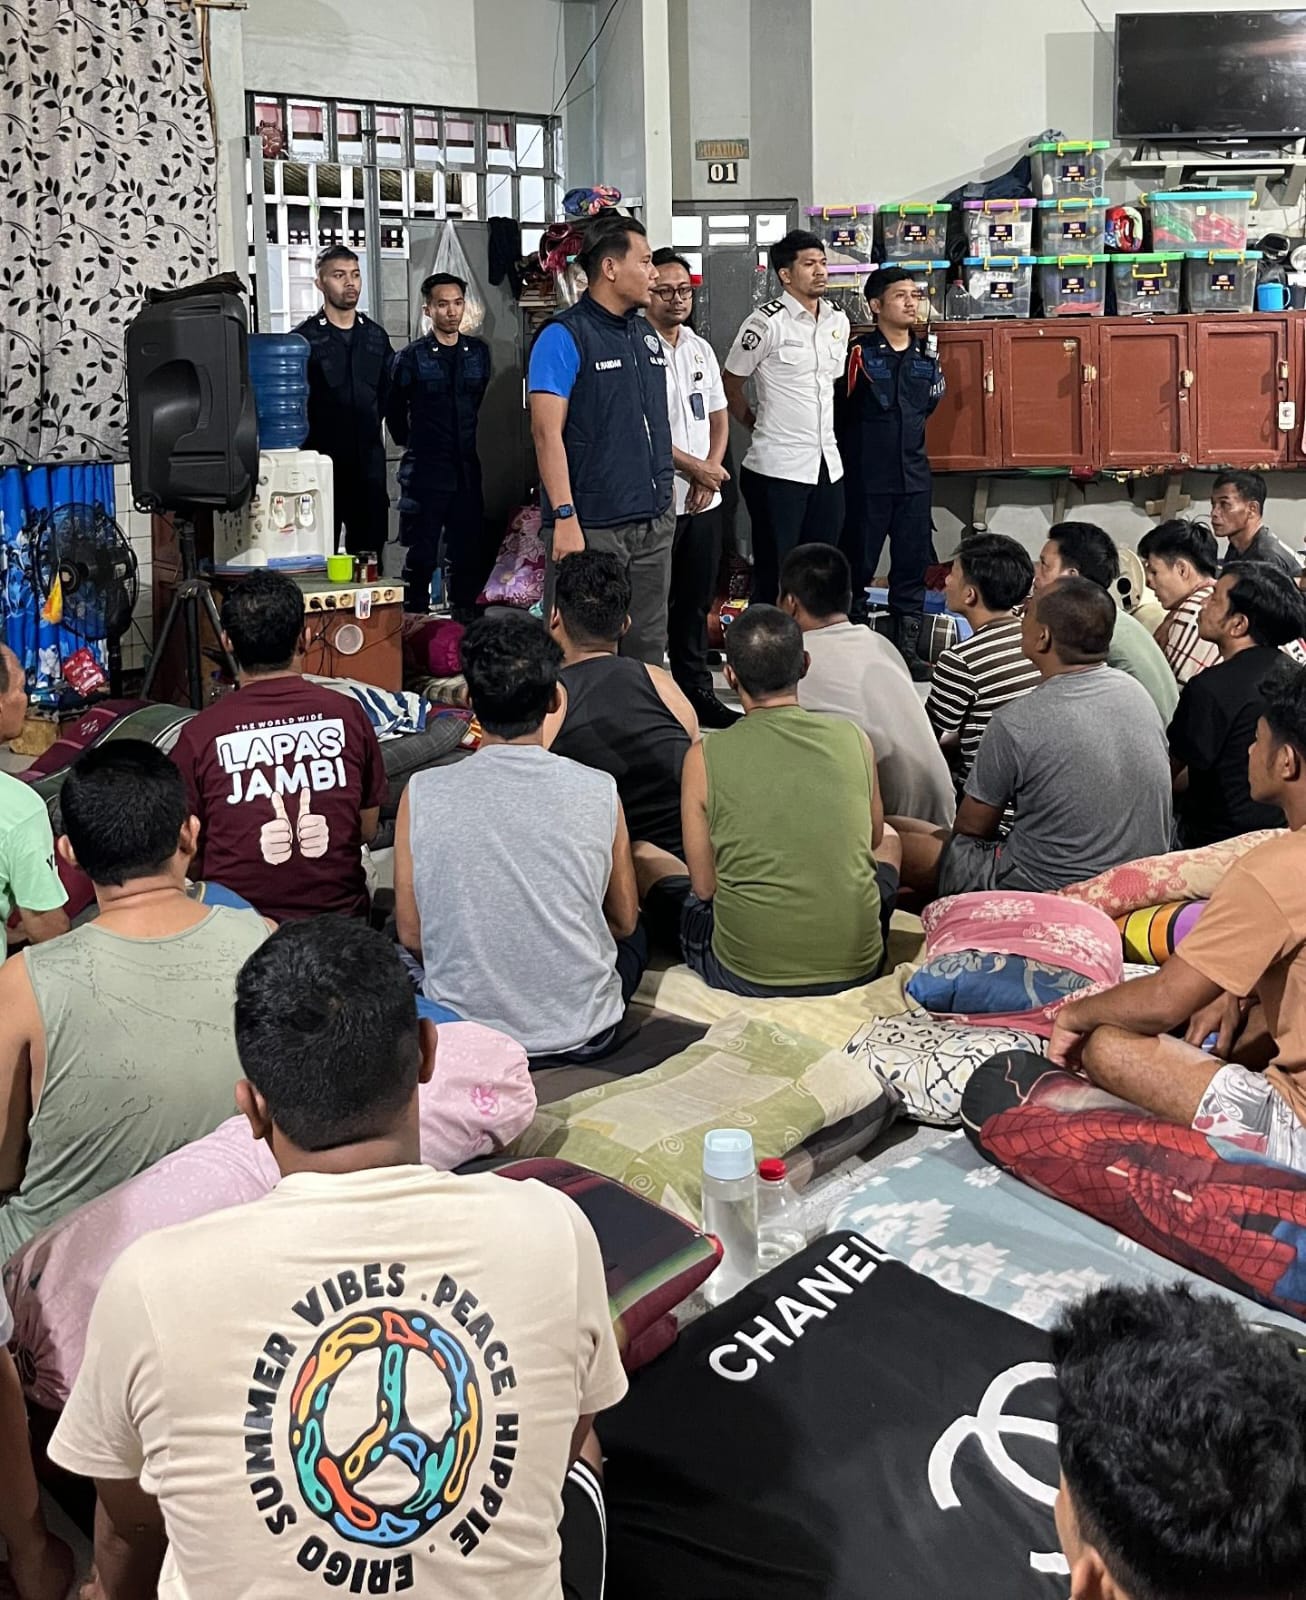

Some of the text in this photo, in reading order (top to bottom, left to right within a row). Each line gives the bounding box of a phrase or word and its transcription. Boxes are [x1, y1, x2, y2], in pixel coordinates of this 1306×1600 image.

[710, 163, 736, 182] 01
[235, 712, 323, 731] THE WORLD WIDE
[220, 727, 342, 773] LAPAS
[227, 757, 347, 804] JAMBI
[243, 1262, 406, 1535] SUMMER VIBES
[432, 1273, 519, 1557] PEACE HIPPIE
[296, 1534, 414, 1595] ERIGO
